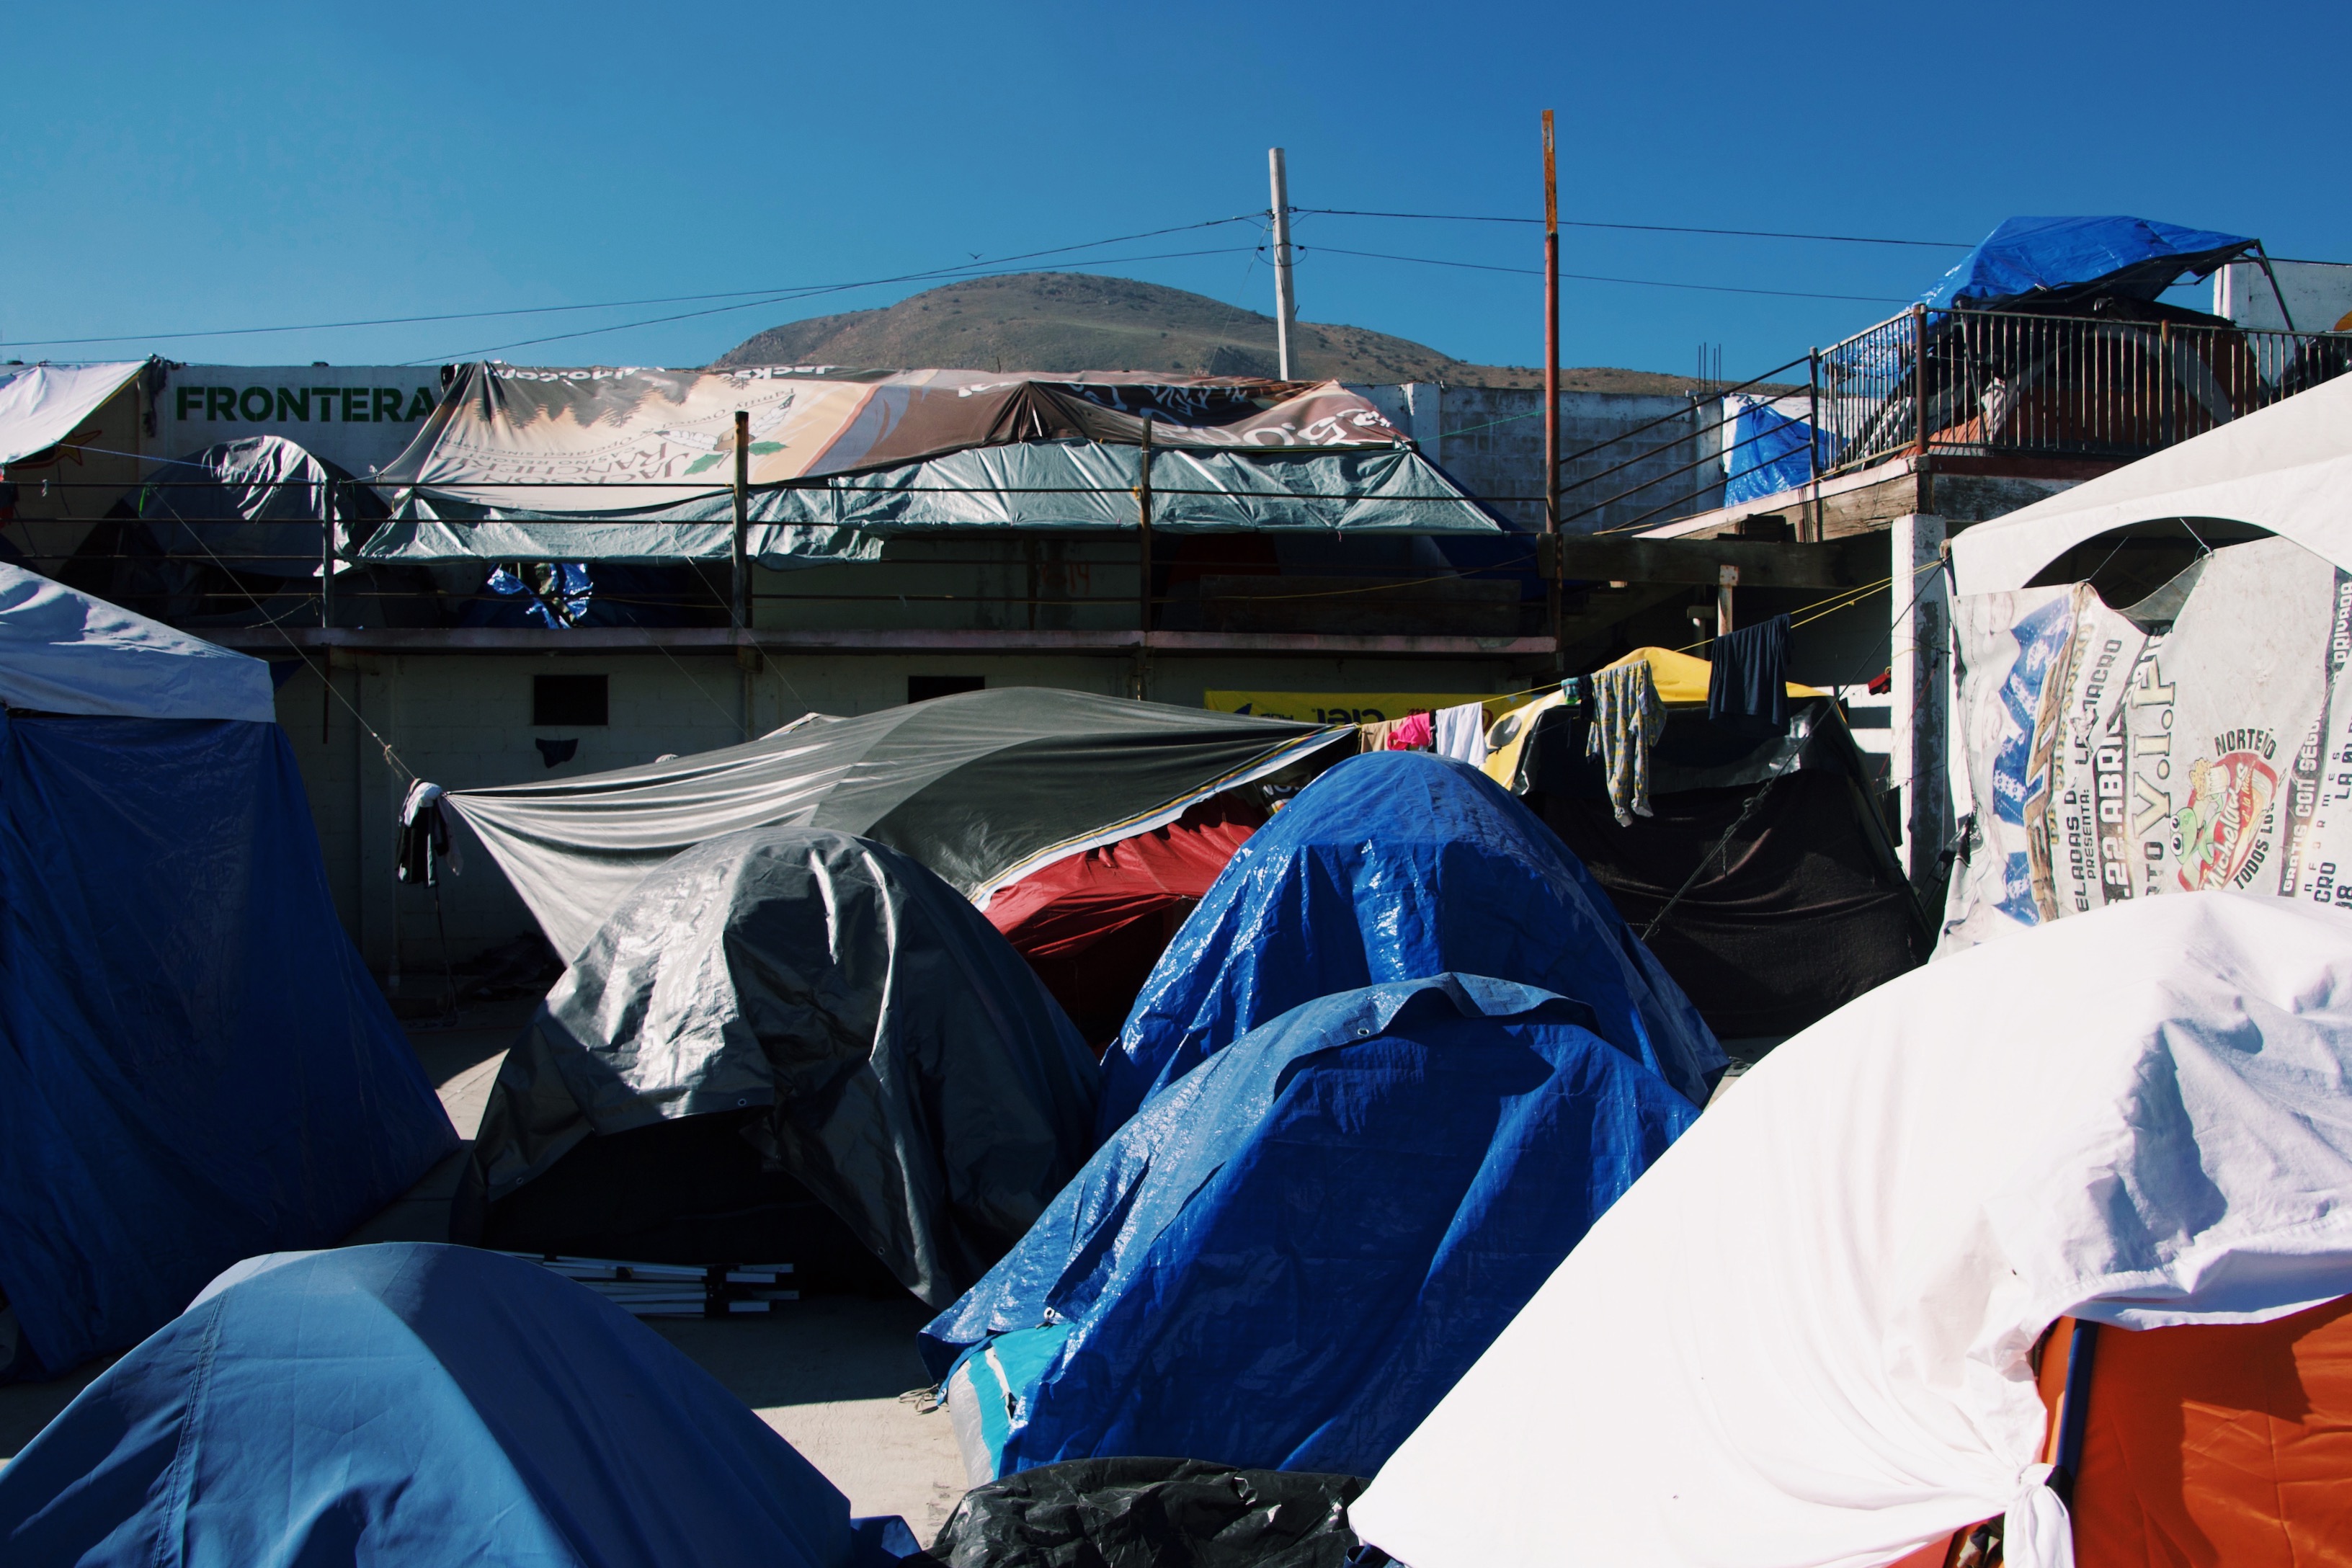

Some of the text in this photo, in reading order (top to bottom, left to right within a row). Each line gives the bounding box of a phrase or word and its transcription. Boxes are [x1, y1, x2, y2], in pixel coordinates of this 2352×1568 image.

[177, 386, 435, 422] FRONTERA
[735, 387, 795, 409] Family
[662, 409, 726, 429] Owned
[466, 447, 636, 466] CASINO RESORT
[486, 447, 534, 457] SINCE
[544, 437, 632, 458] Operated
[482, 453, 690, 486] JACKSON
[2079, 789, 2096, 880] PRESENTA:
[2066, 816, 2089, 912] ELADAS
[2232, 839, 2270, 891] TODOS
[2282, 824, 2308, 893] GRATIS
[2313, 862, 2336, 903] CRO
